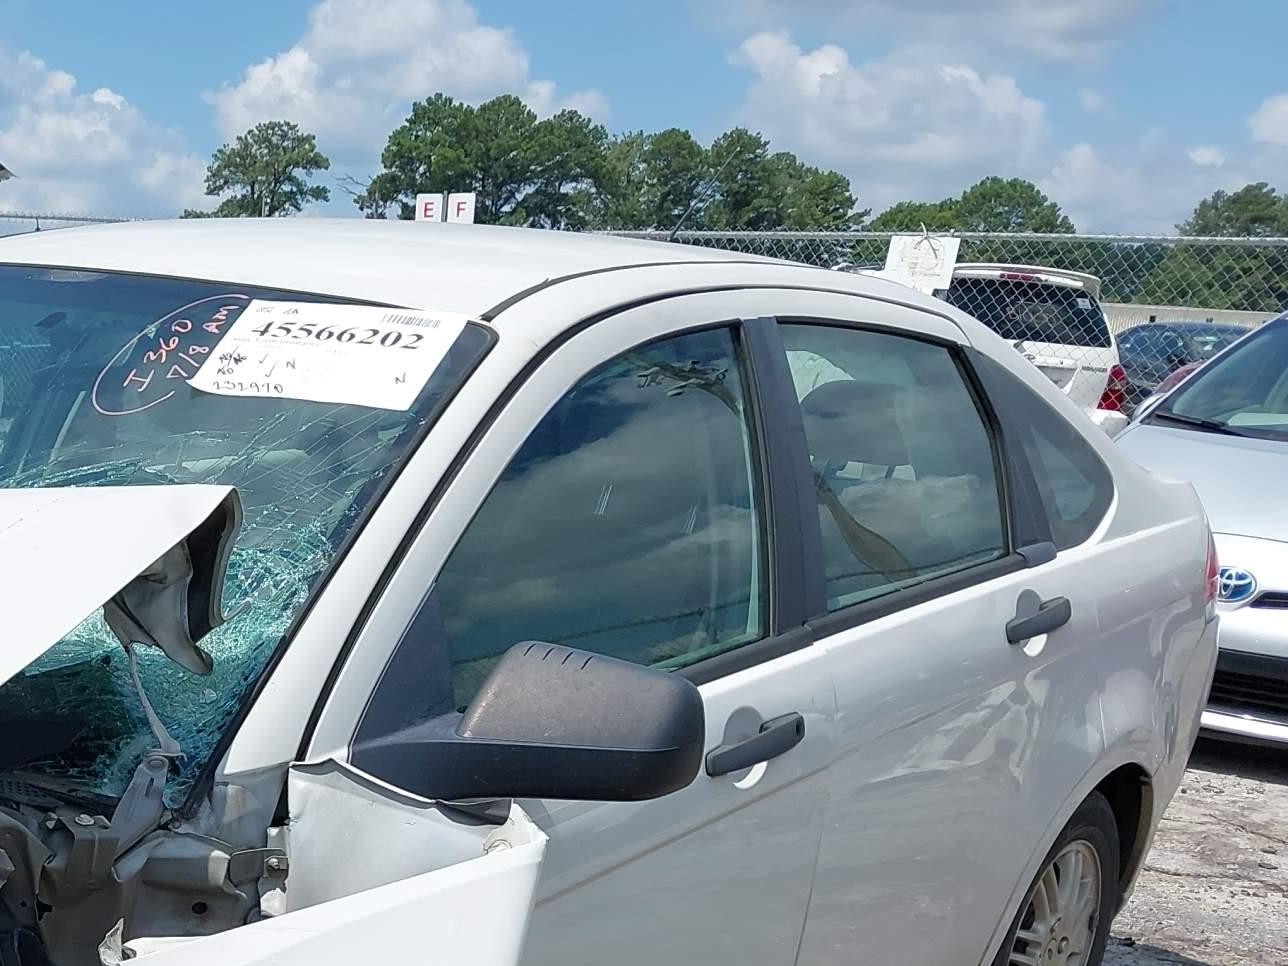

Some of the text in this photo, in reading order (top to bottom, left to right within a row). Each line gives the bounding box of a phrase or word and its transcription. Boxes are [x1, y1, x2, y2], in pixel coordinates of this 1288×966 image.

[423, 201, 435, 218] E
[456, 201, 467, 218] F
[251, 320, 425, 350] 45566202
